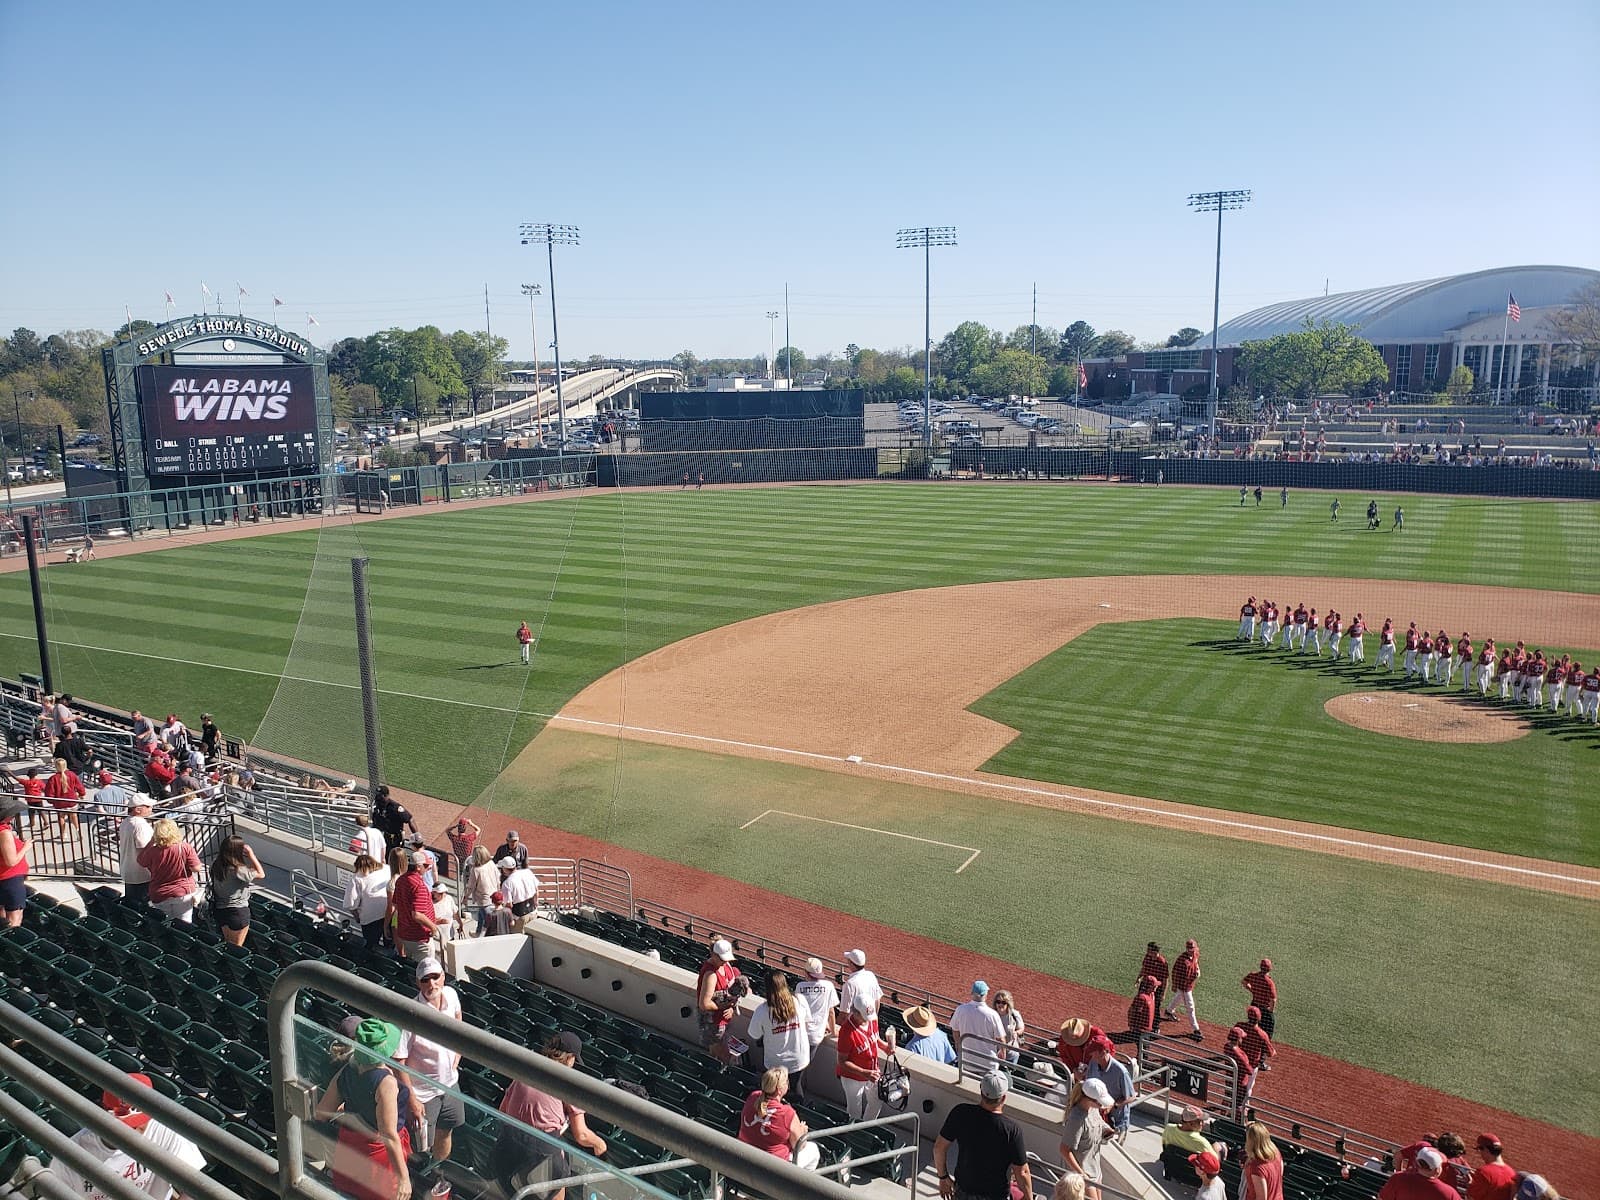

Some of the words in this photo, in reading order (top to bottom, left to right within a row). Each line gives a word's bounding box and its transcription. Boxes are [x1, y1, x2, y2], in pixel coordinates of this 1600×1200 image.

[139, 320, 250, 354] SEWELL-THOMAS
[256, 326, 308, 356] STADIUM
[169, 378, 292, 394] ALABAMA
[175, 394, 289, 421] WINS
[1170, 1070, 1178, 1079] P
[1190, 1076, 1200, 1088] N
